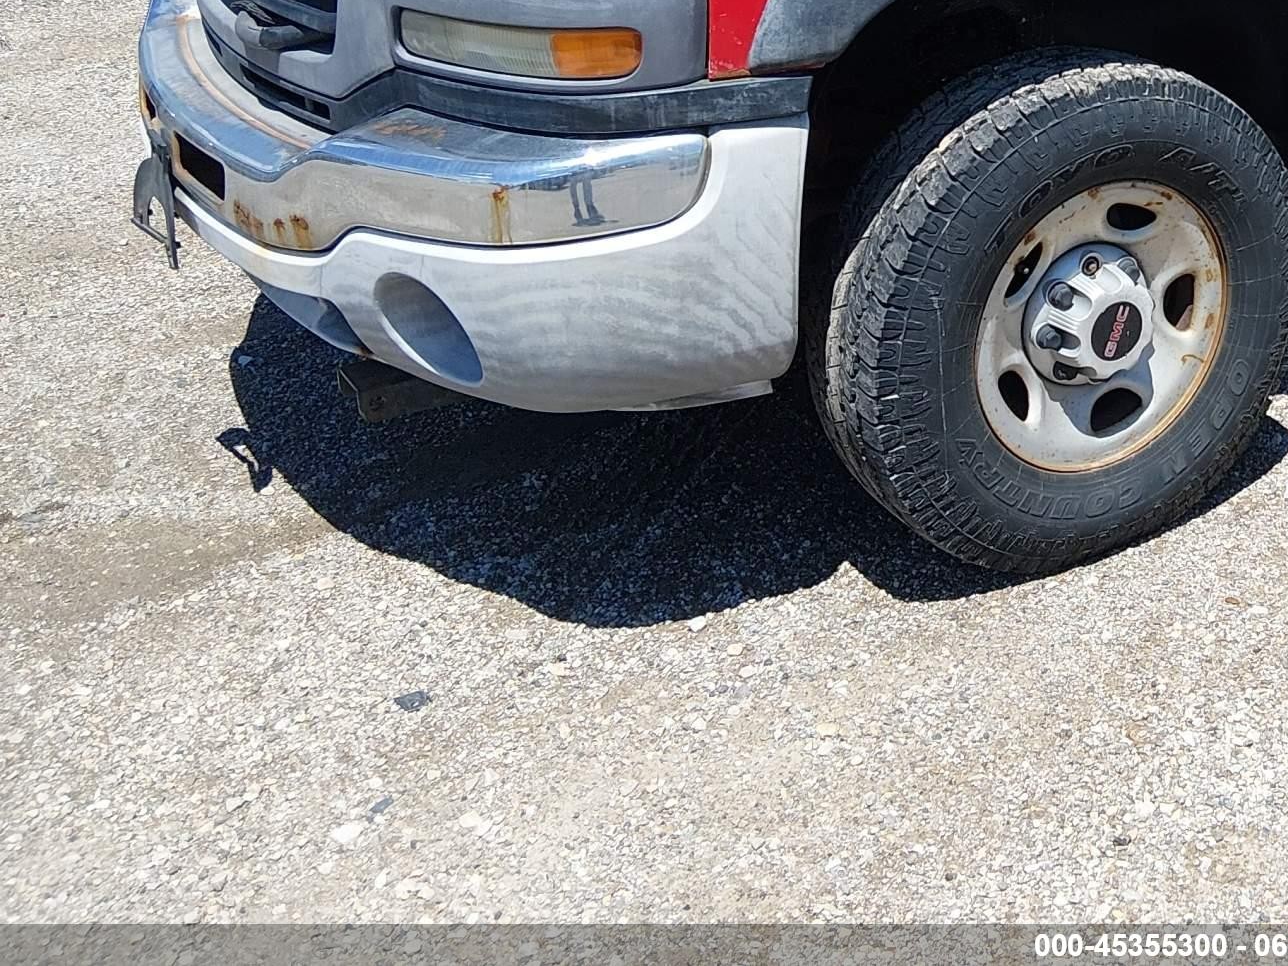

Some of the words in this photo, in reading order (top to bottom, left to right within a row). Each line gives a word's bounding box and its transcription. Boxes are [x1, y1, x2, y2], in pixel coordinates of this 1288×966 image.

[1104, 304, 1130, 358] GMC
[1161, 357, 1250, 485] OPEN
[954, 438, 1145, 520] COUNTRY
